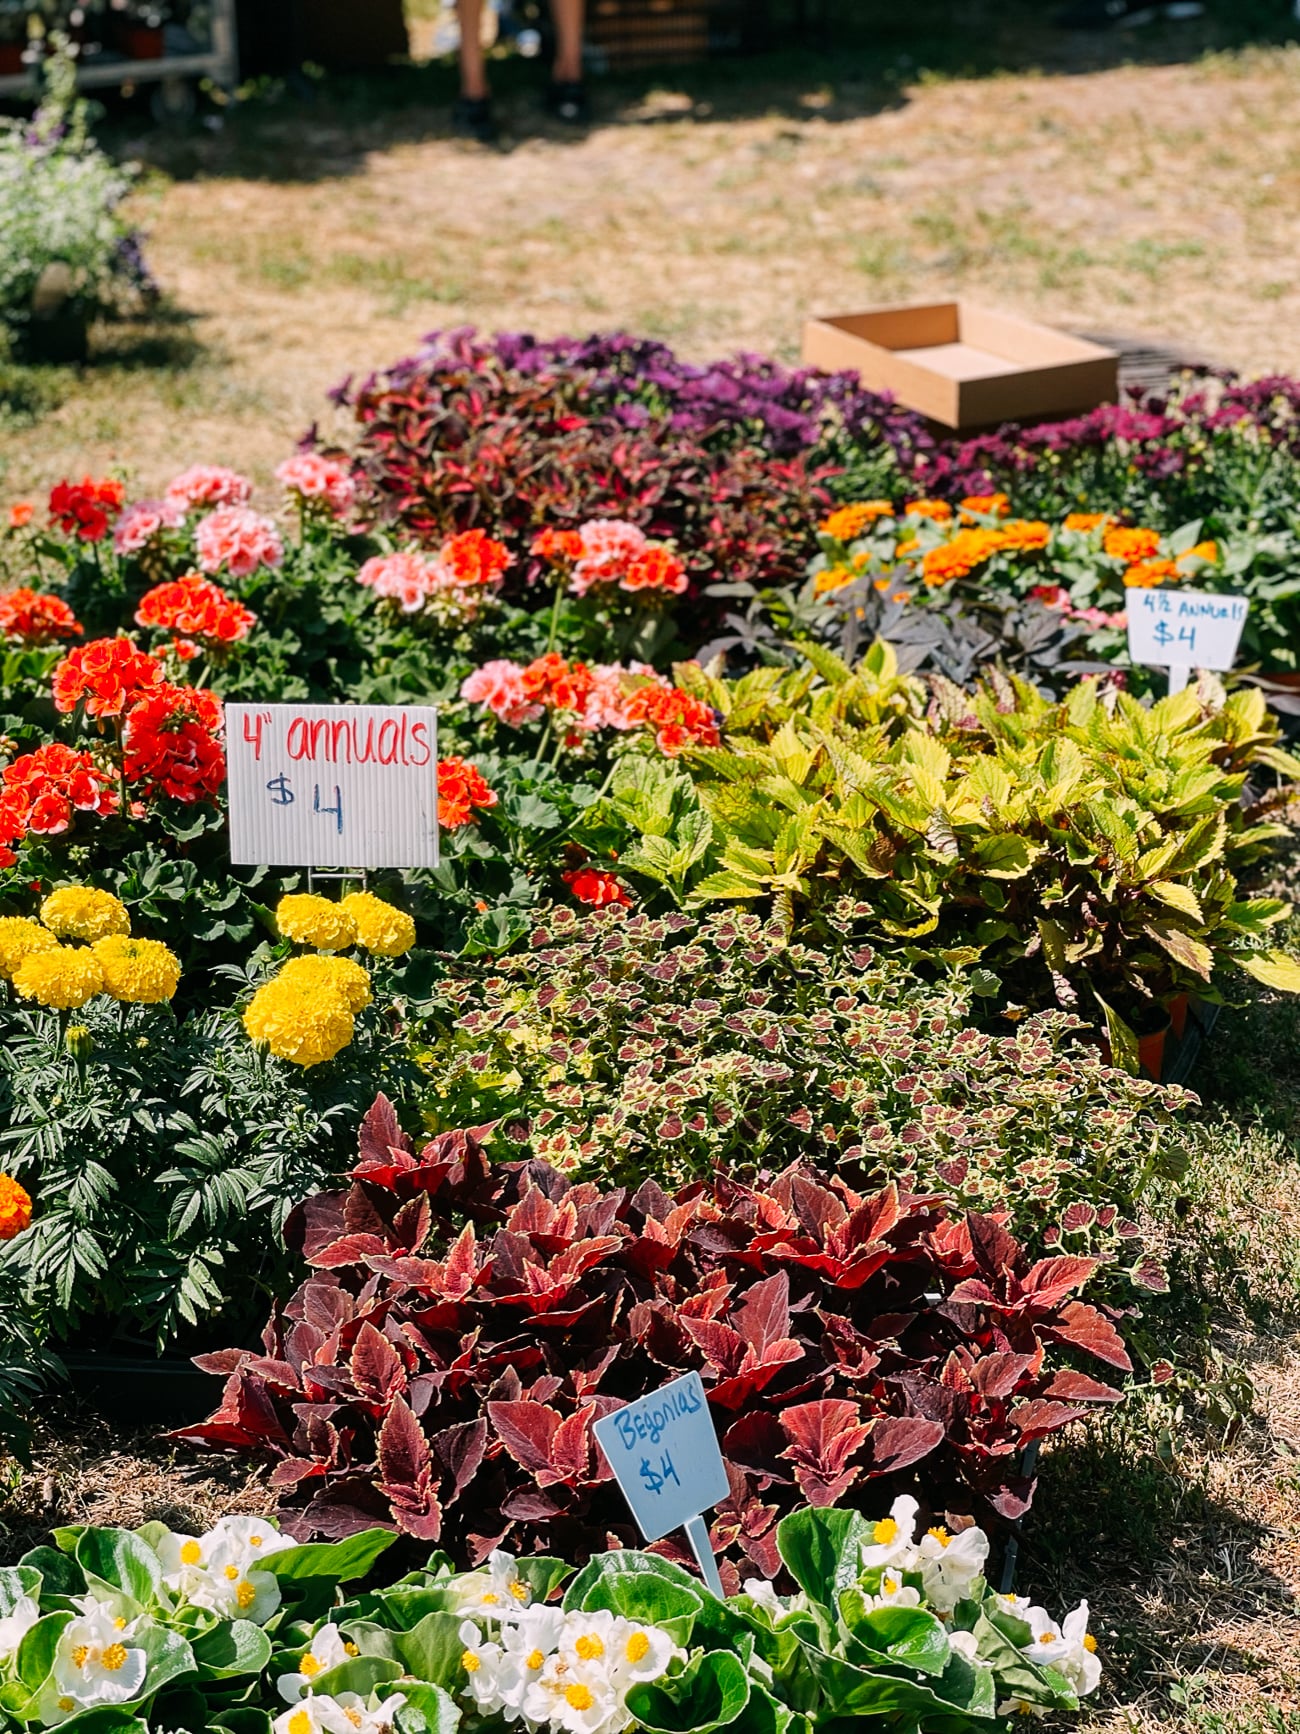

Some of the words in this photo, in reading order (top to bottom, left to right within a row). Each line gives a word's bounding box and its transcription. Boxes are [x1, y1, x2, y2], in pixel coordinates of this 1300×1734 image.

[1153, 620, 1196, 650] $4
[287, 712, 431, 766] annuals
[639, 1448, 680, 1495] $4
